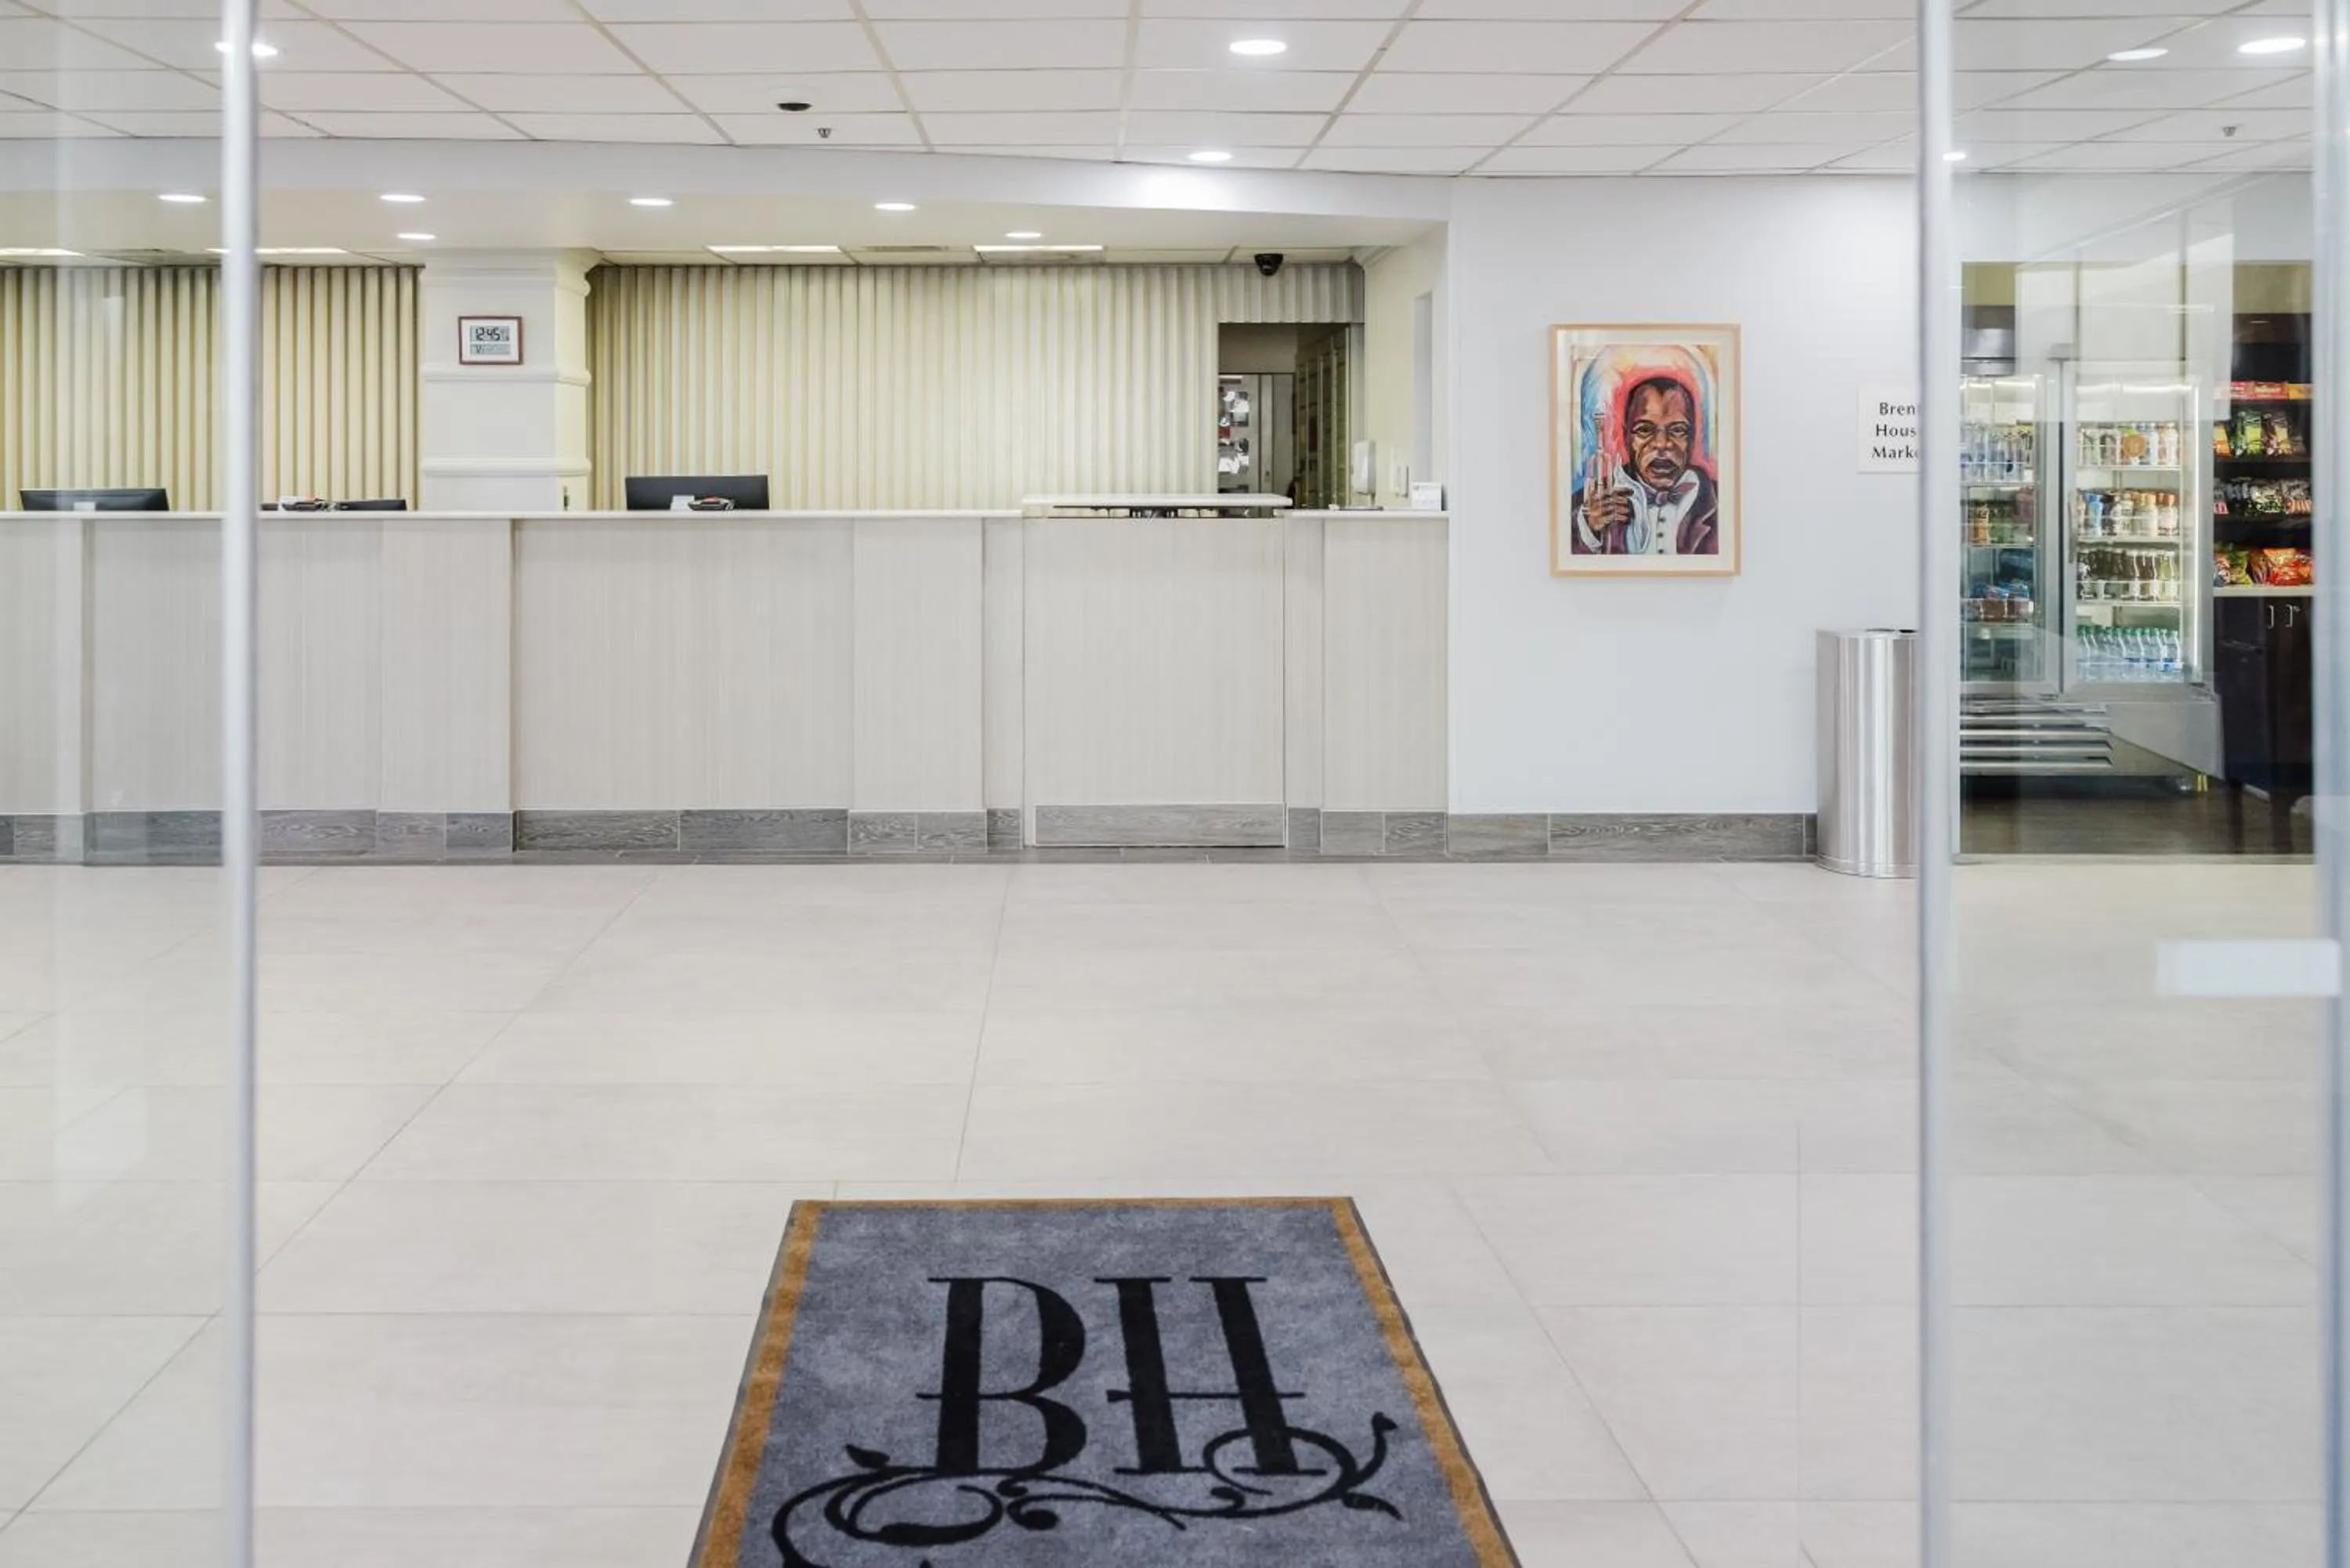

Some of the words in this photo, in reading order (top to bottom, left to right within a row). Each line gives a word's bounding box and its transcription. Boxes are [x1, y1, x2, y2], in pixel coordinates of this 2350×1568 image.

[1879, 402, 1917, 415] Bren
[1875, 424, 1918, 437] Hous
[916, 1277, 1305, 1476] BH
